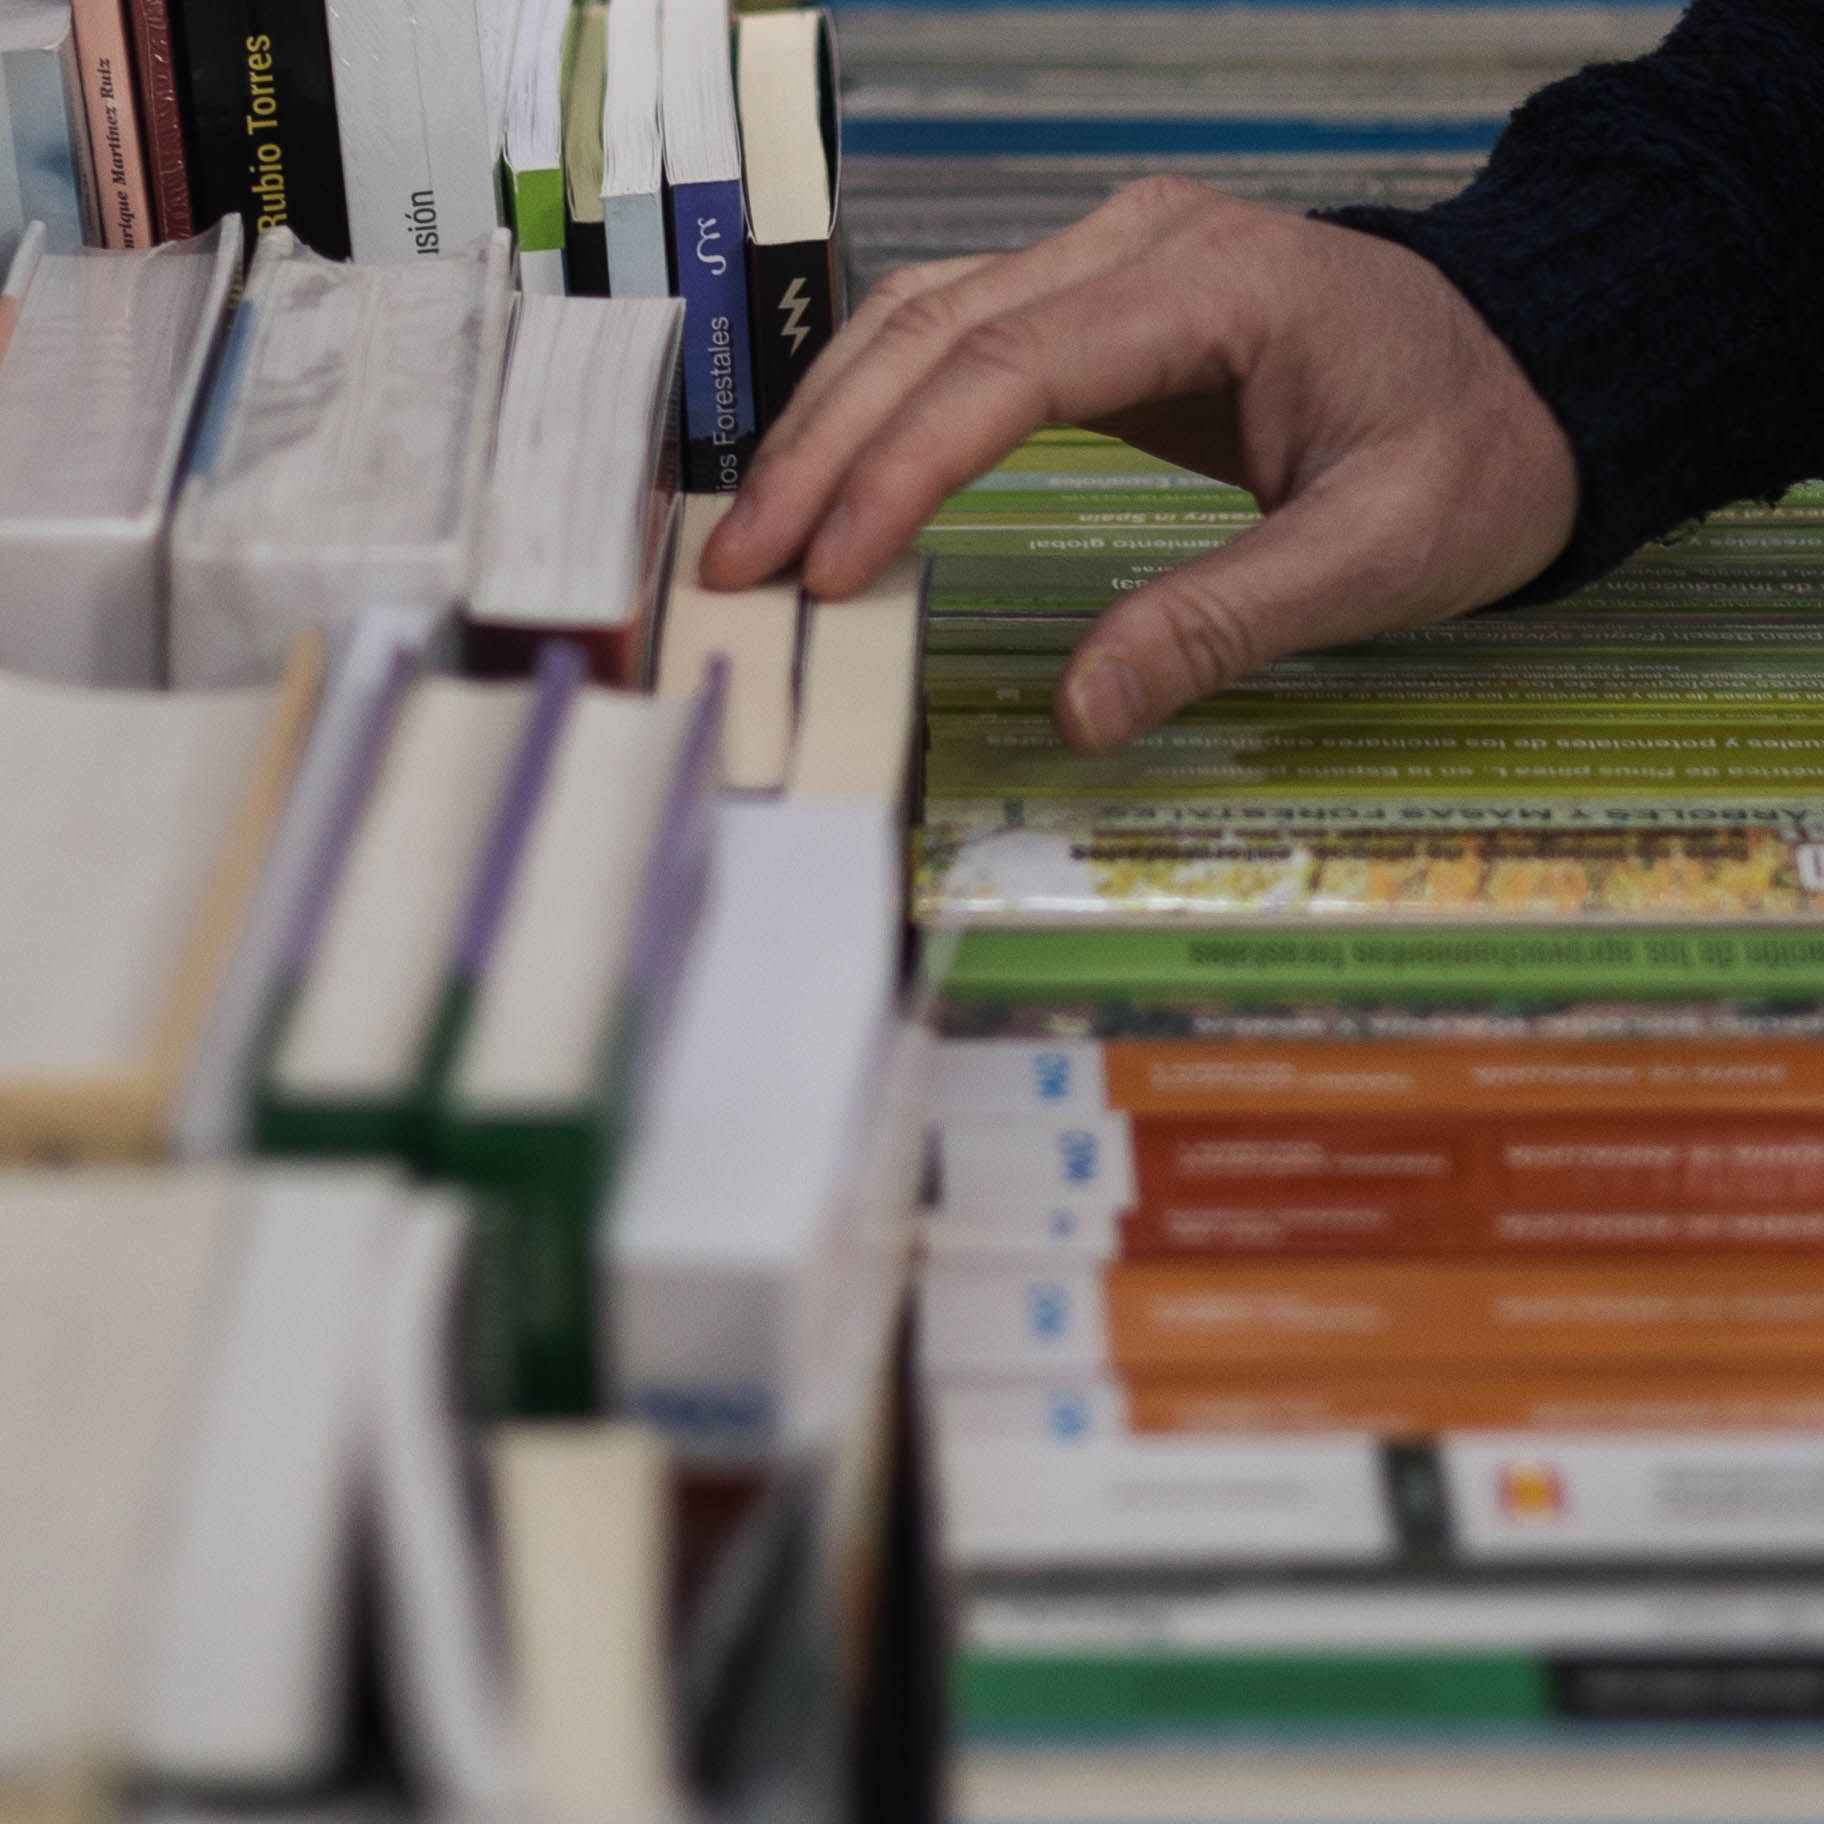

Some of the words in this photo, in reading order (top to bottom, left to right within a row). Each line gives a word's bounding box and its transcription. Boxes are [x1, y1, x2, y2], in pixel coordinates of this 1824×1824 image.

[98, 58, 113, 98] Ruiz
[245, 33, 278, 135] Torres
[104, 111, 127, 186] Martínez
[249, 142, 289, 234] Rubio
[112, 190, 136, 251] nrique
[404, 189, 439, 256] sión
[711, 315, 737, 445] Forestales
[715, 457, 738, 496] ios
[1078, 512, 1147, 525] Spain
[1029, 537, 1104, 551] global
[1112, 538, 1228, 550] tamiento
[1607, 582, 1773, 595] Introducción
[1780, 583, 1812, 595] de
[1170, 735, 1315, 750] españoles
[1321, 737, 1458, 749] encinares
[1465, 738, 1507, 750] los
[1514, 738, 1548, 750] de
[1555, 737, 1717, 751] potenciales
[1294, 765, 1399, 779] España
[1407, 767, 1433, 778] la
[1438, 767, 1474, 778] en
[1513, 765, 1592, 778] pinea
[1597, 766, 1677, 779] Pinus
[1684, 766, 1721, 778] de
[1102, 807, 1388, 820] FORESTALES
[1399, 807, 1553, 820] MASAS
[1604, 808, 1810, 825] ÁRBOLES
[1187, 938, 1347, 971] forestales
[1350, 938, 1634, 971] aprovechamientos
[1646, 939, 1690, 970] los
[1700, 939, 1736, 969] de
